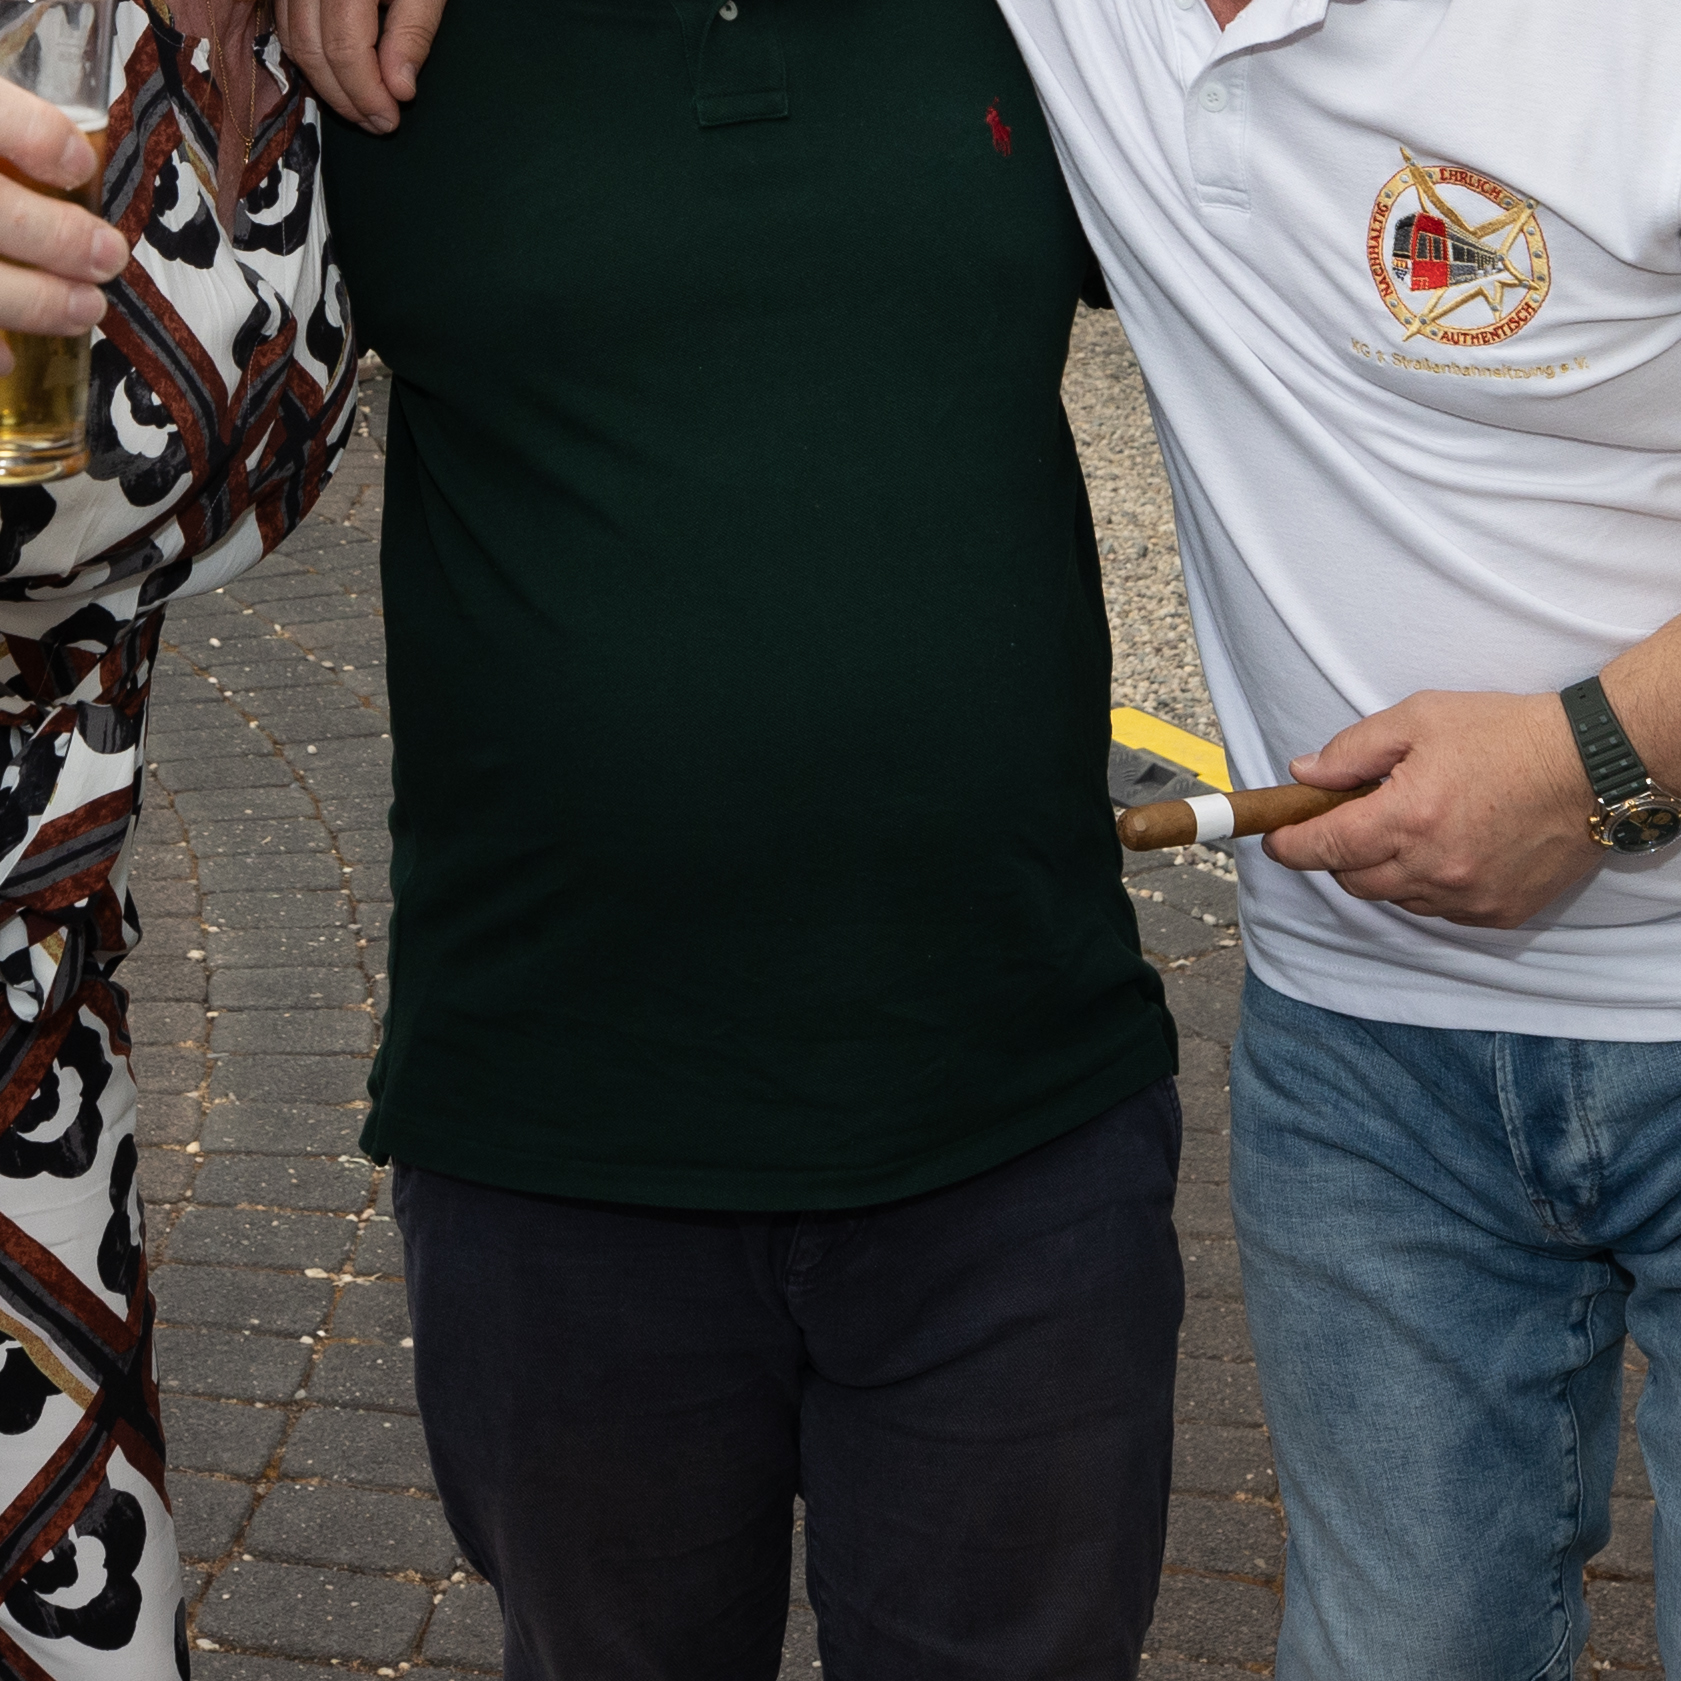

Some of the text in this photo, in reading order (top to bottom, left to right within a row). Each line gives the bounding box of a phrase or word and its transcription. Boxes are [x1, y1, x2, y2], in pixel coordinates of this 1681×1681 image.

[1439, 167, 1502, 200] EHRLICH
[1369, 201, 1394, 298] NACHHALTIG
[1439, 301, 1536, 346] AUTHENTISCH
